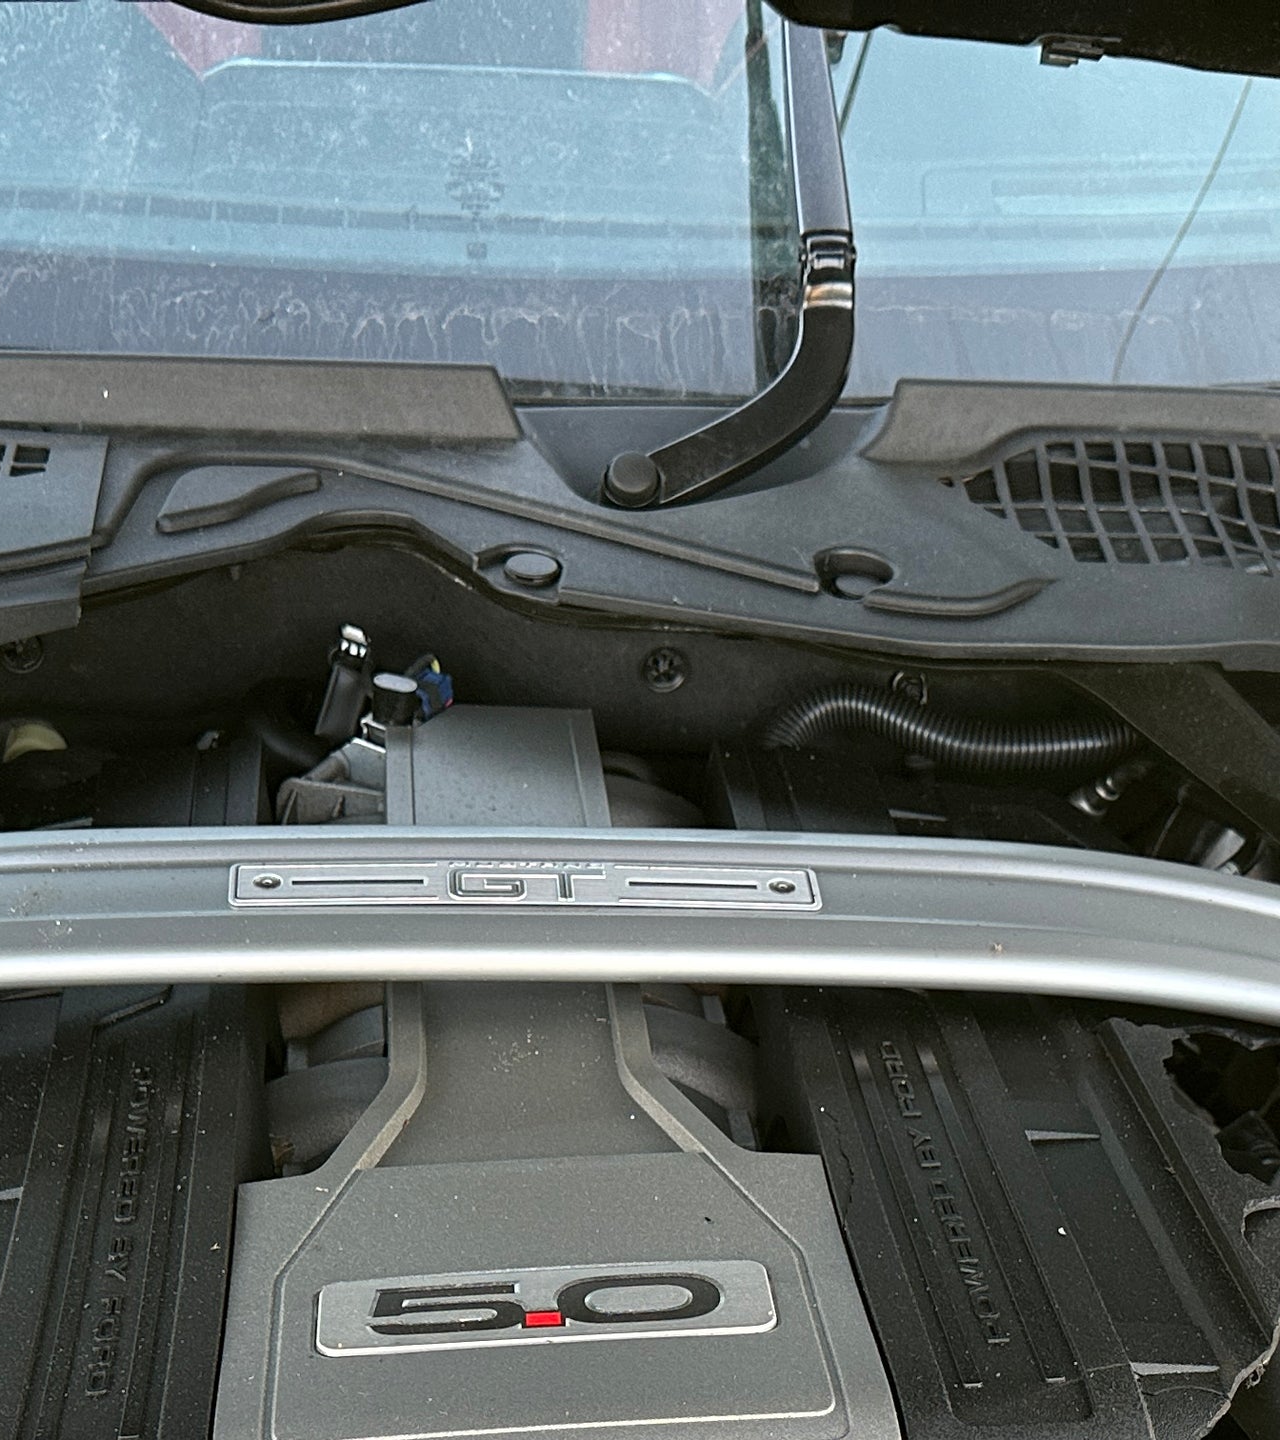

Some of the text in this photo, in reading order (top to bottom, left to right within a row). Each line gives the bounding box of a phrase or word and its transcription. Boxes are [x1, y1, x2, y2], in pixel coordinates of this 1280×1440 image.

[447, 868, 607, 902] GT
[880, 1040, 1010, 1344] POWERED BY FORD
[105, 1237, 131, 1282] BY
[365, 1272, 724, 1335] 5.0
[84, 1297, 120, 1397] FORD
